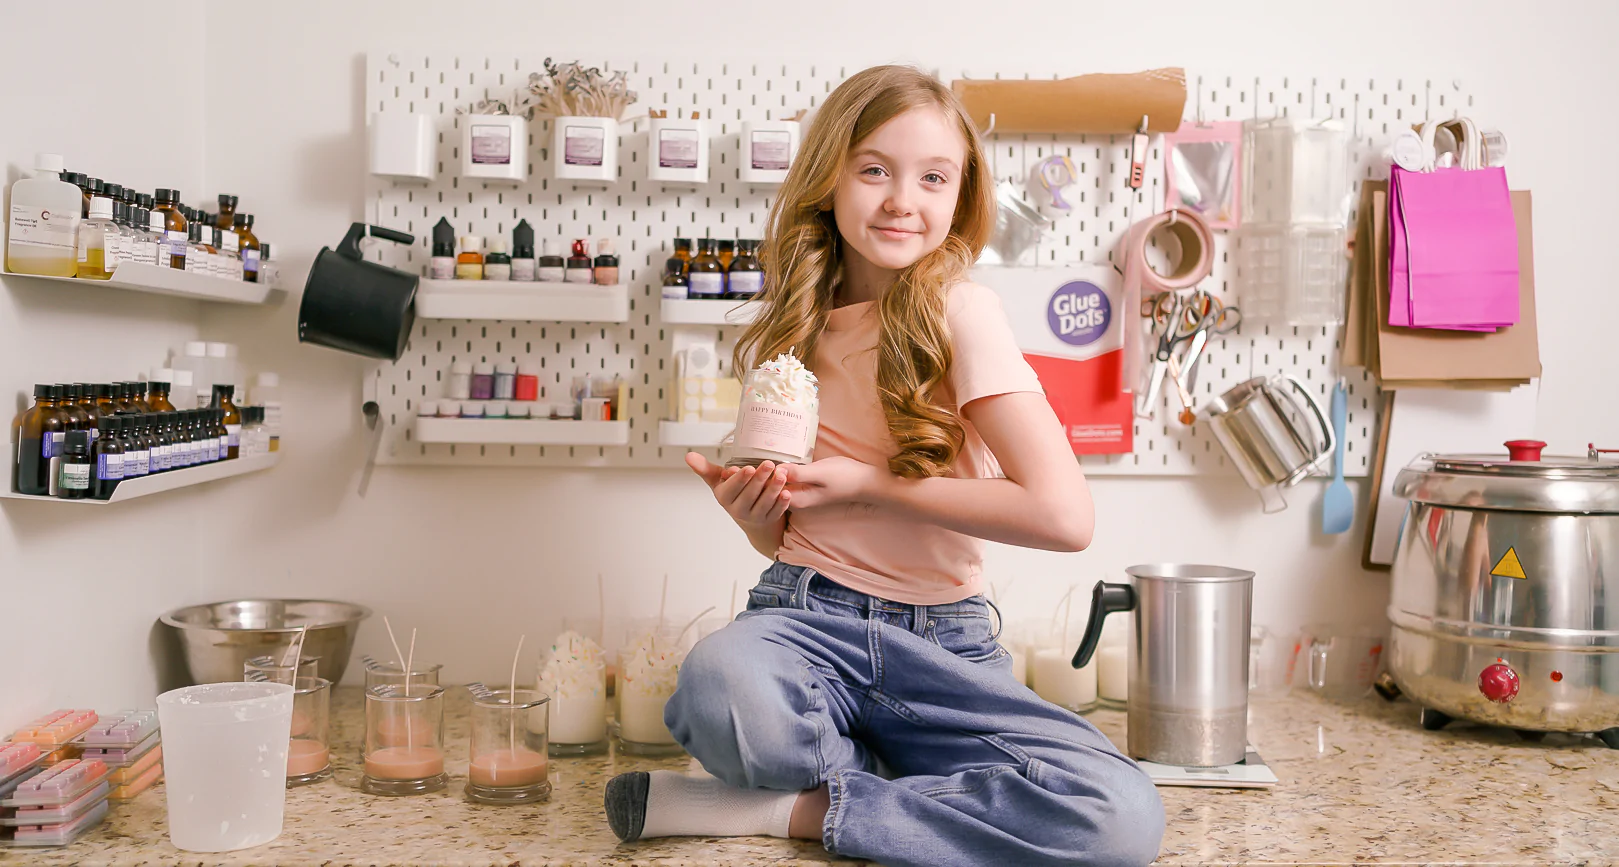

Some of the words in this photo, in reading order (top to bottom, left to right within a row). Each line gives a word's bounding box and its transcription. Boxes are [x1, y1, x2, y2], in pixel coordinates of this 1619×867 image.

[1053, 292, 1100, 315] Glue
[1059, 308, 1104, 335] Dots
[771, 408, 802, 419] BIRTHDAY
